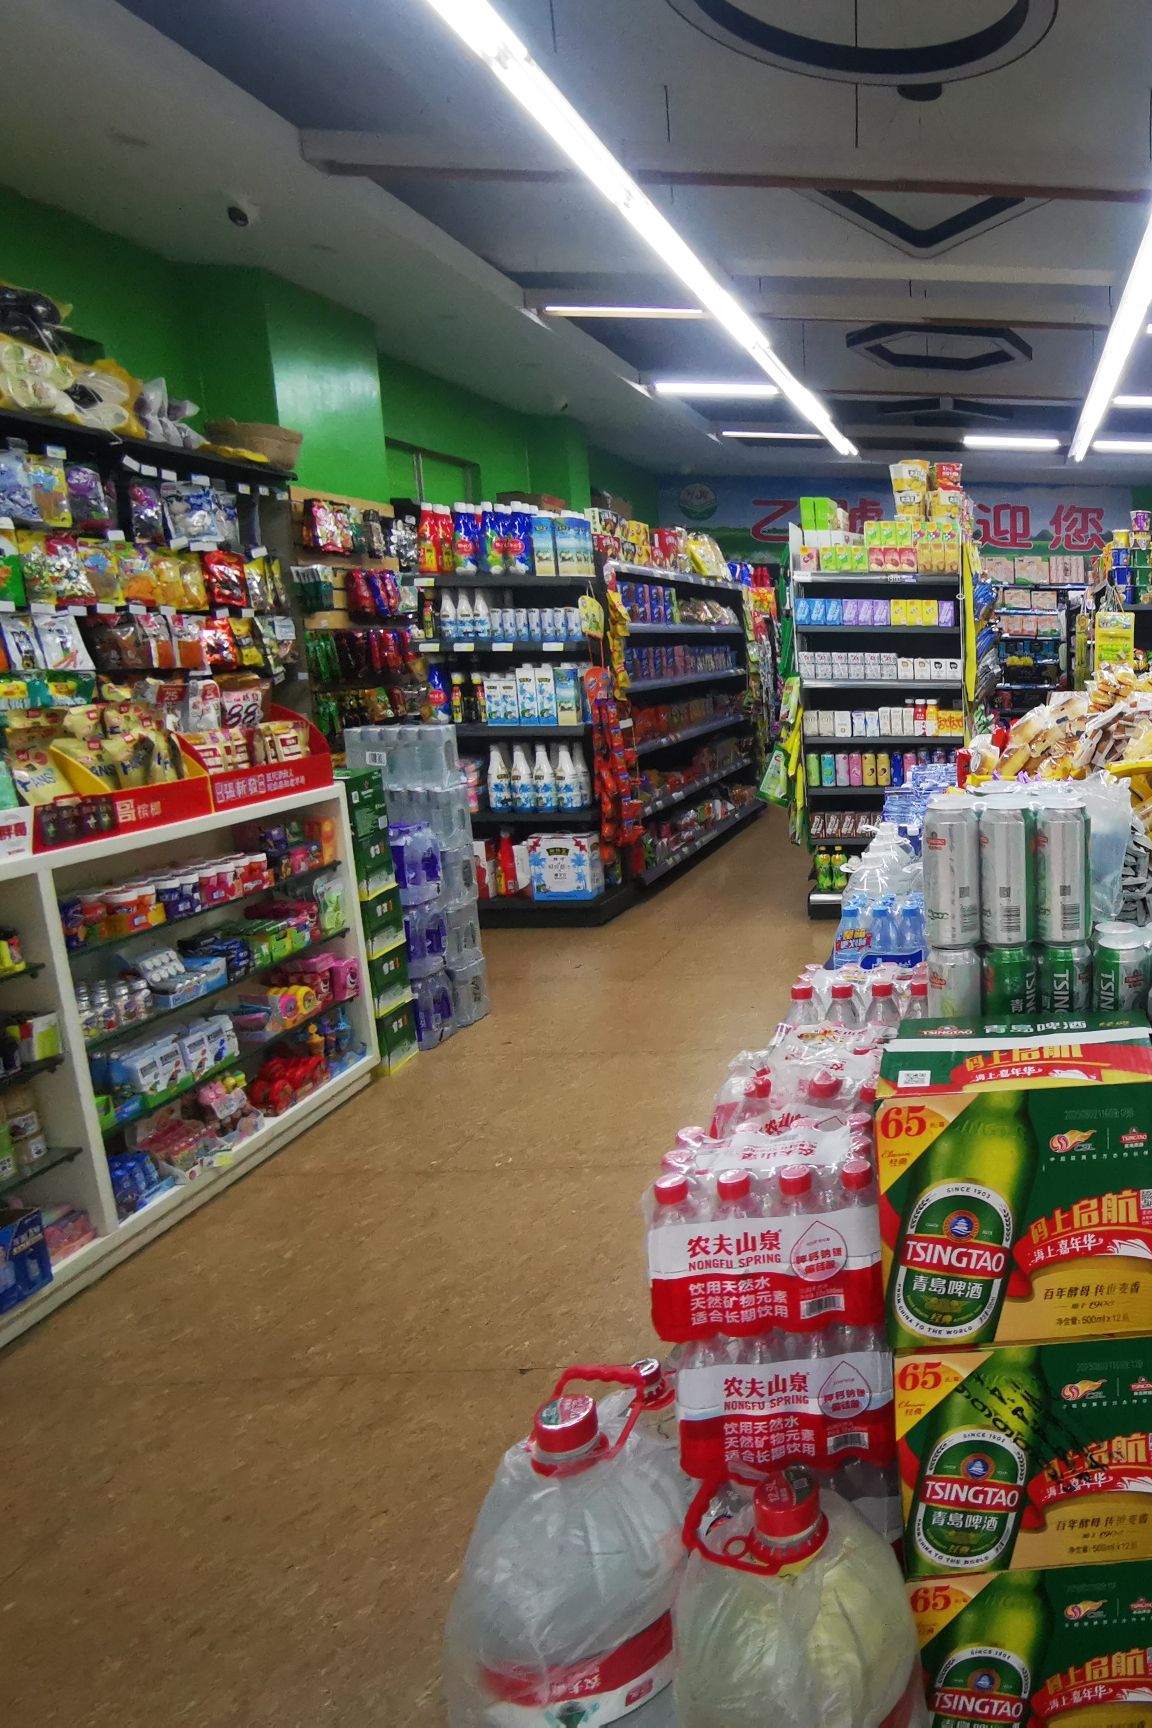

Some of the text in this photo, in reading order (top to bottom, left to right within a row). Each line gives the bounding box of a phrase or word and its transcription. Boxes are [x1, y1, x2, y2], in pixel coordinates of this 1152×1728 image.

[881, 1105, 926, 1139] 65
[1031, 1189, 1139, 1244] 码上启航
[687, 1230, 781, 1258] 农夫山泉
[906, 1240, 1005, 1273] TSINGTAO
[688, 1253, 781, 1271] NONGFU SPRING
[688, 1276, 771, 1296] 饮用天然水
[690, 1291, 788, 1311] 天然矿物元素
[691, 1305, 788, 1326] 适合长期饮用
[724, 1372, 809, 1398] 农夫山泉
[898, 1362, 942, 1391] 65
[724, 1395, 809, 1411] NONGFU SPRING
[724, 1415, 799, 1435] 饮用天然水
[724, 1429, 815, 1449] 天然矿物元素
[926, 1480, 1019, 1507] TSINGTAO
[911, 1585, 950, 1613] 65
[935, 1692, 1023, 1718] TSINGTAO
